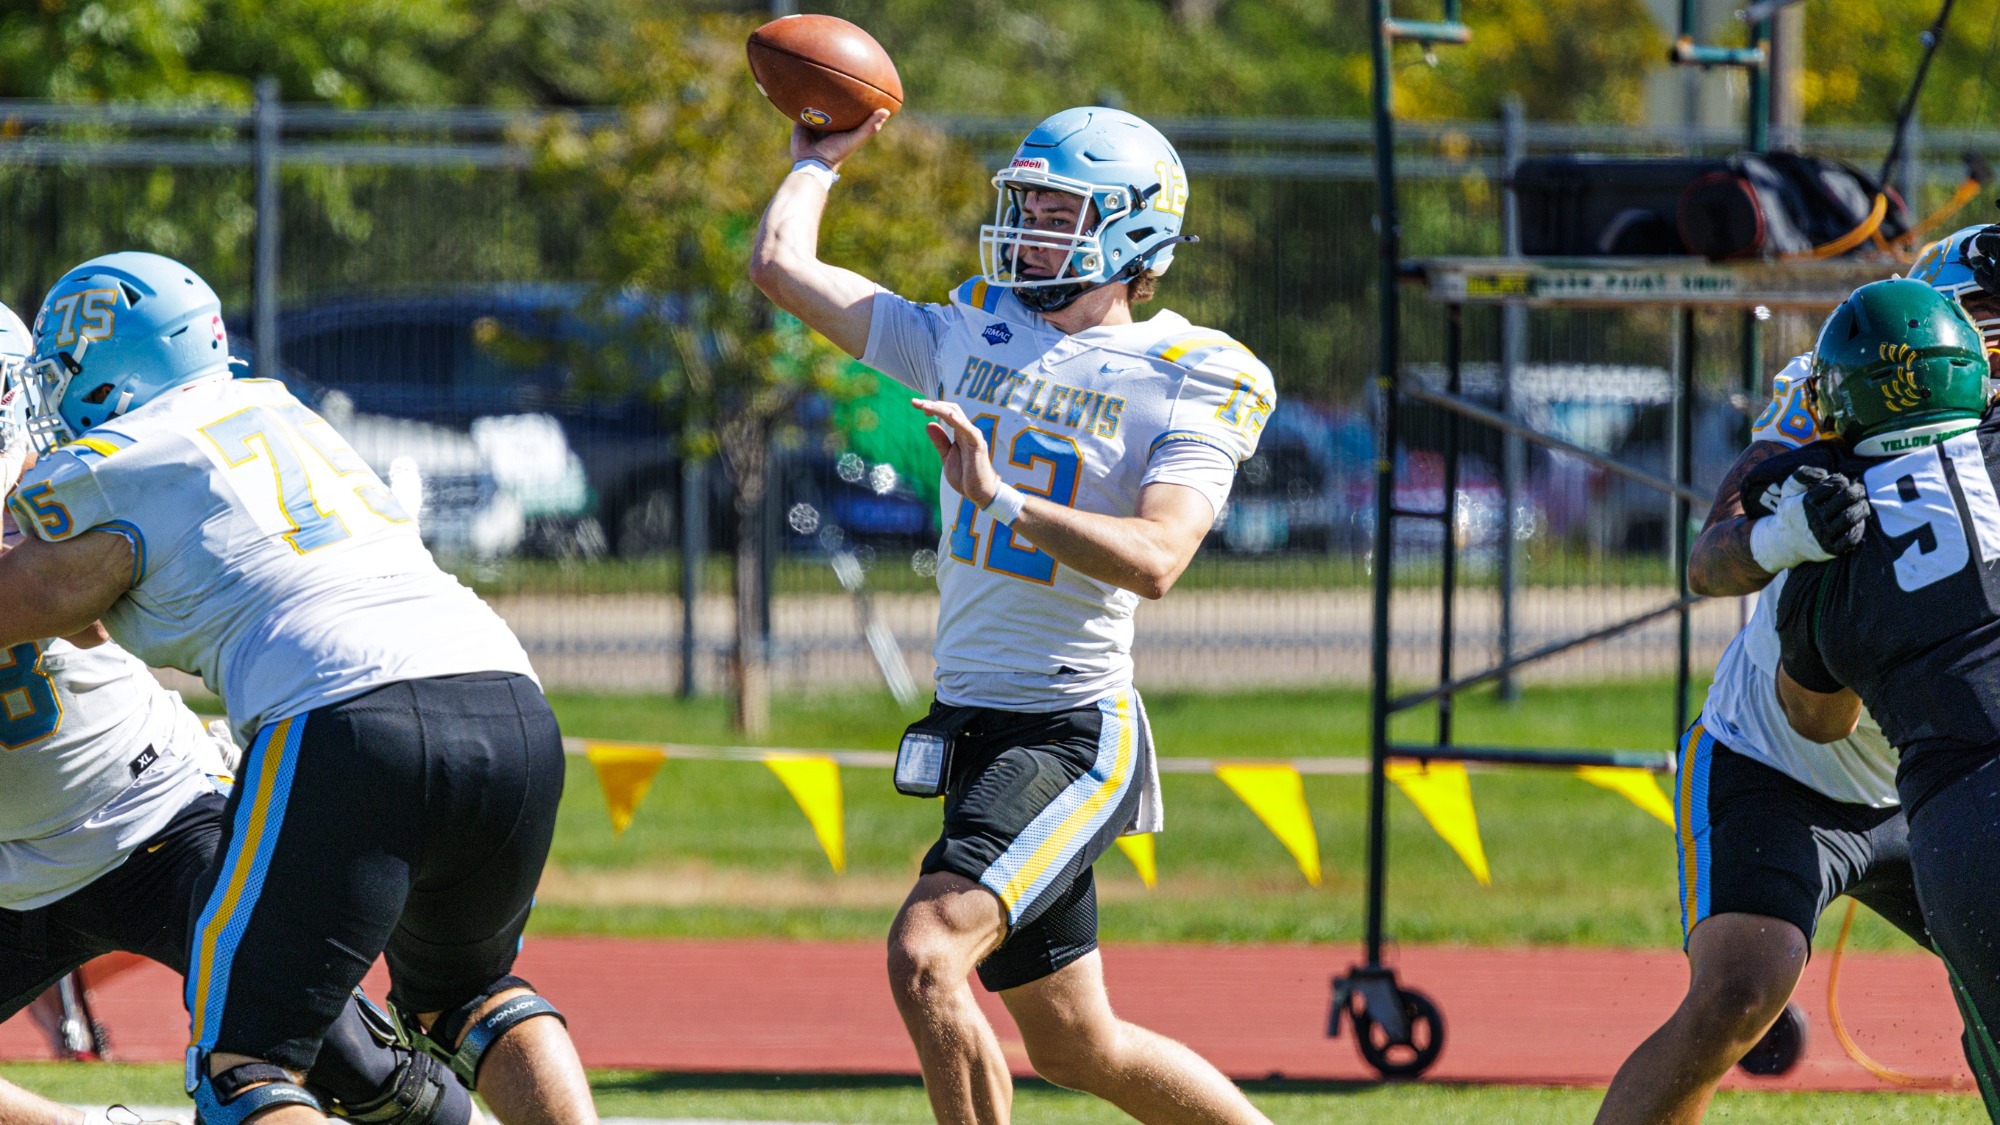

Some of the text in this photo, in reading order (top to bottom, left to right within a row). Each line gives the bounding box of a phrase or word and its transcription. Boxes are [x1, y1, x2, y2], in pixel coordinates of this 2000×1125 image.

[1153, 161, 1187, 217] 12
[54, 290, 118, 347] 75
[985, 327, 1010, 341] RMAC
[954, 355, 1126, 439] FORT LEWIS
[1214, 372, 1274, 450] 12
[1881, 434, 1931, 452] YELLOW
[198, 404, 412, 555] 75
[950, 412, 1083, 586] 12
[137, 753, 154, 769] XL
[486, 1000, 537, 1028] DONJOY
